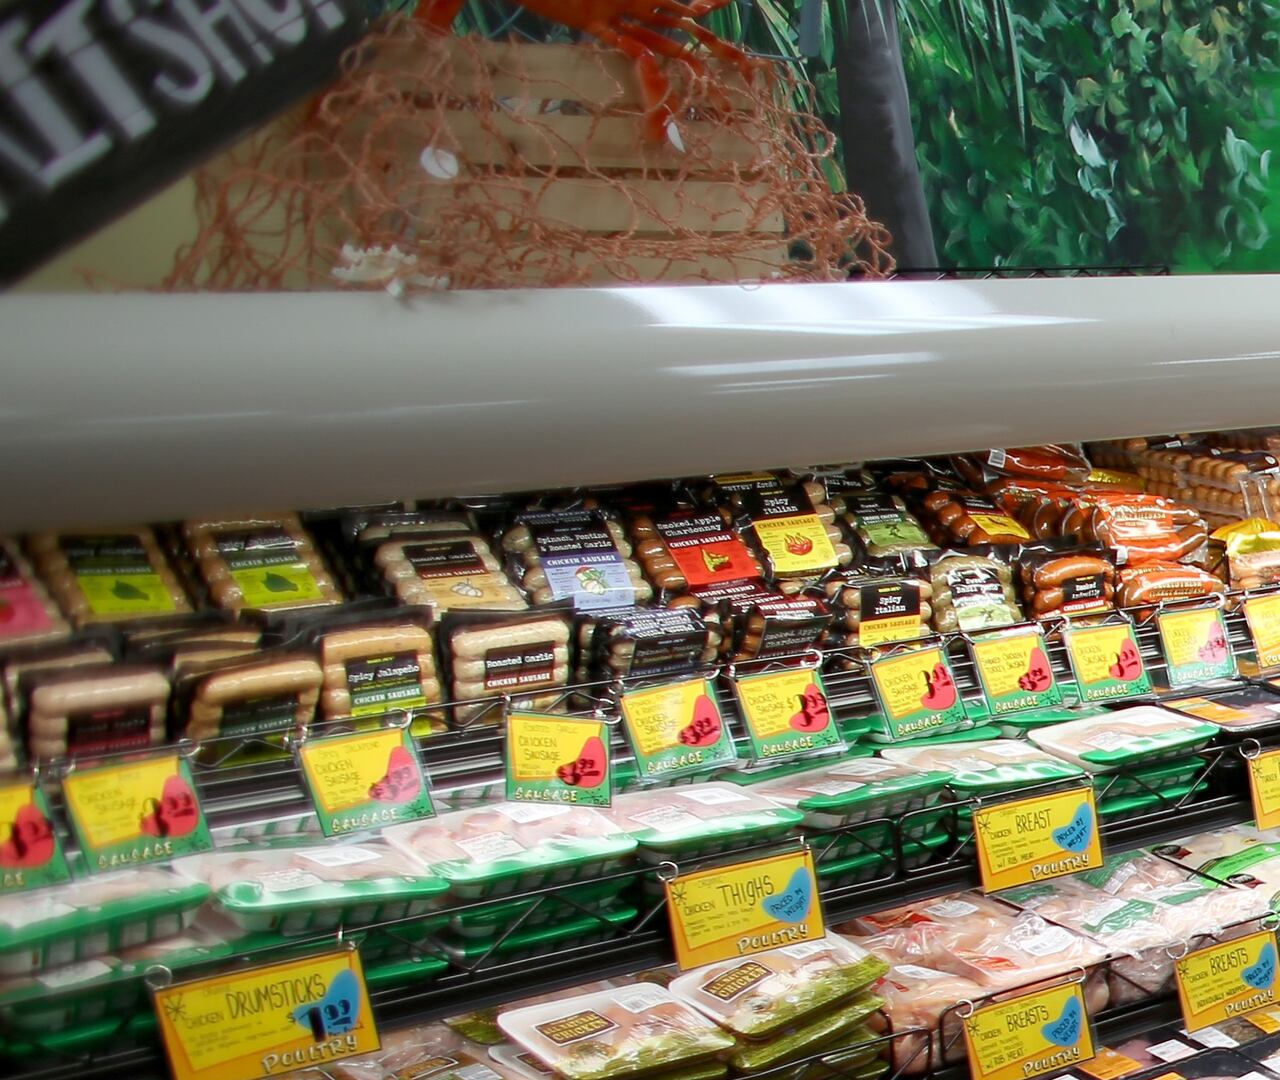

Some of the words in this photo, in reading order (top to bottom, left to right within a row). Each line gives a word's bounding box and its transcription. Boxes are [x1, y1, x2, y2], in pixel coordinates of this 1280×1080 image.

[763, 504, 799, 515] Italian
[764, 497, 789, 508] Spicy
[694, 514, 722, 526] Apple
[758, 520, 786, 529] CHICKEN
[787, 517, 816, 526] SAUSAGE
[665, 523, 722, 538] Chardonnay
[669, 539, 700, 549] CHICKEN
[700, 534, 732, 545] SAUSAGE
[546, 557, 580, 567] CHICKEN
[581, 554, 617, 564] SAUSAGE
[874, 603, 907, 615] Italian
[879, 595, 902, 605] Spicy
[864, 622, 889, 631] CHICKEN
[890, 619, 917, 628] SAUSAGE
[486, 657, 523, 669] Roasted
[524, 652, 555, 664] Garlic
[348, 670, 375, 683] Spicy
[487, 677, 518, 688] CHICKEN
[519, 672, 551, 683] SAUSAGE
[354, 692, 386, 705] CHICKEN
[387, 687, 421, 699] SAUSAGE
[1086, 685, 1129, 700] SAUSAGE
[994, 695, 1039, 714] SAUSAGE
[896, 713, 944, 736] SAUSAGE
[518, 735, 558, 749] CHICKEN
[762, 736, 814, 757] SAUSAGE
[647, 750, 703, 774] SAUSAGE
[514, 786, 578, 802] SAUSAGE
[330, 807, 399, 833] SAUSAGE
[989, 828, 1012, 840] CHICKEN
[1015, 808, 1052, 835] BREAST
[99, 841, 174, 869] SAUSAGE
[1031, 853, 1090, 880] POULTRY
[684, 900, 716, 917] CHICKEN
[716, 874, 775, 907] THIGHS
[771, 894, 793, 914] PRICED
[737, 923, 808, 954] POULTRY
[1209, 946, 1249, 976] BREASTS
[719, 965, 767, 998] CHICKEN
[225, 973, 327, 1020] DRUMSTICKS
[1224, 989, 1275, 1018] POULTRY
[553, 1020, 608, 1043] CHICKEN
[979, 1028, 1002, 1041] CHICKEN
[1005, 1004, 1050, 1033] BREASTS
[261, 1035, 359, 1075] POULTRY
[1022, 1047, 1080, 1078] POULTRY
